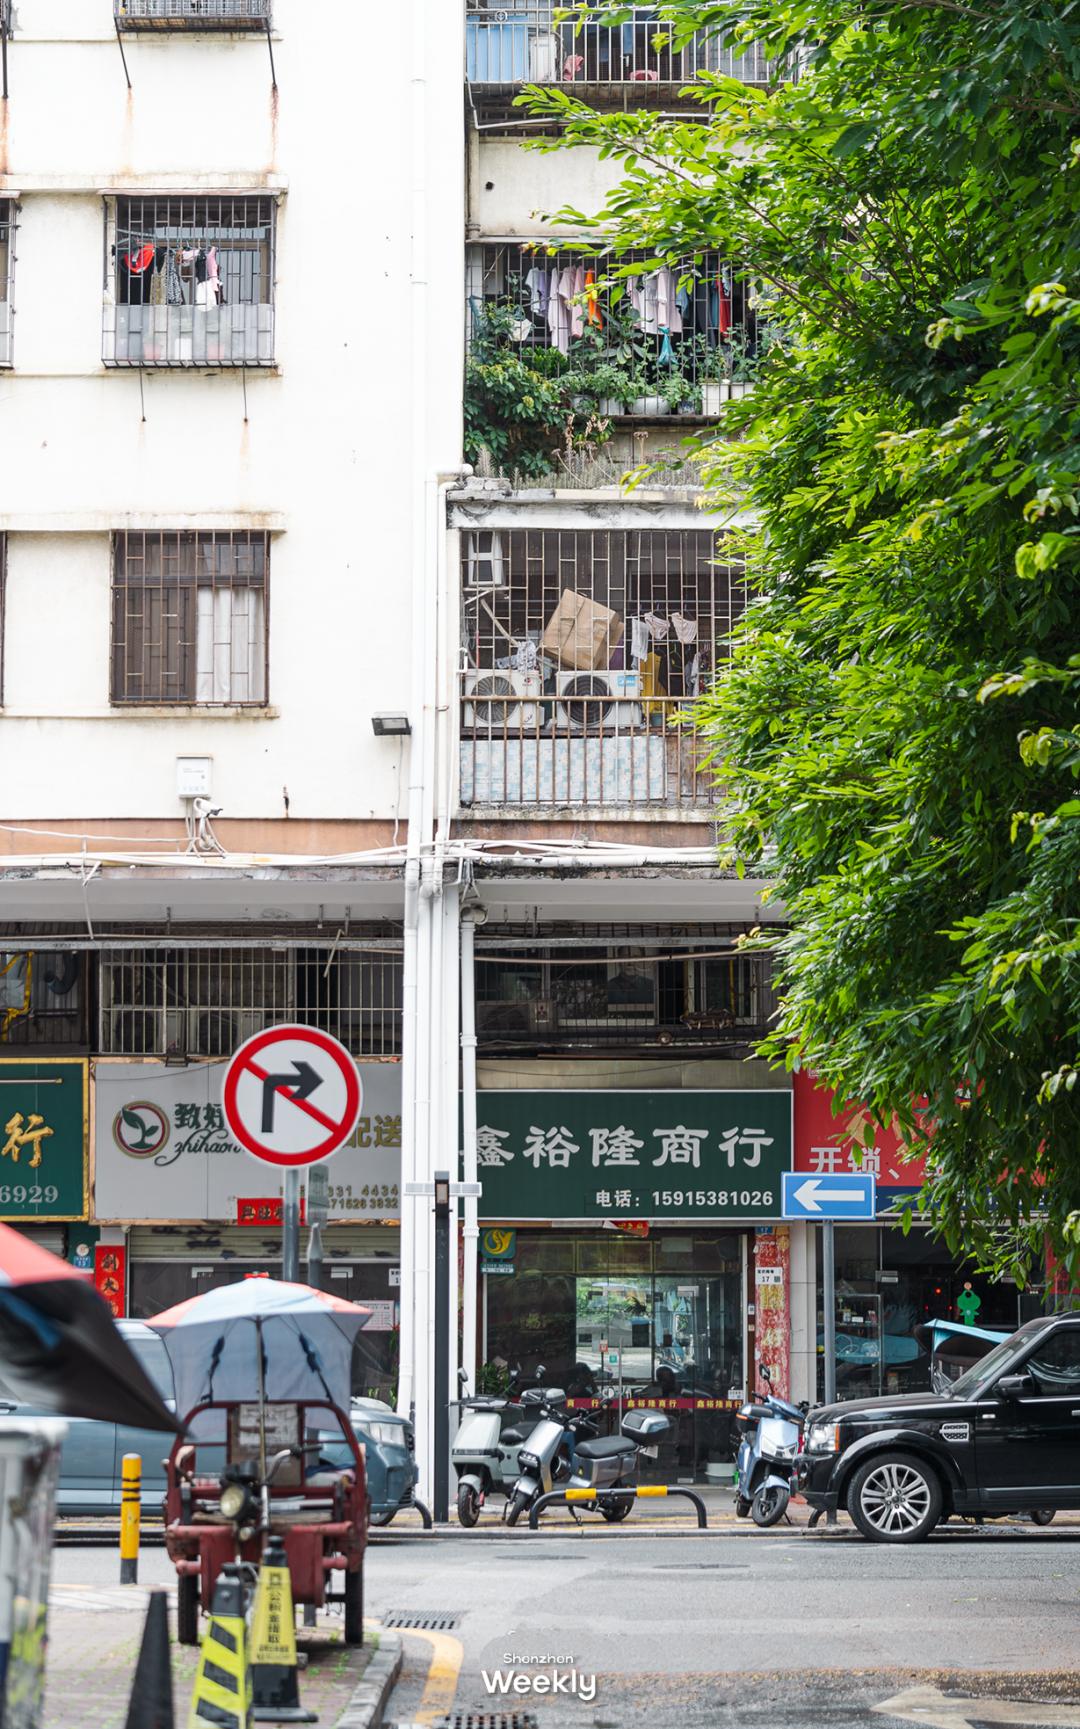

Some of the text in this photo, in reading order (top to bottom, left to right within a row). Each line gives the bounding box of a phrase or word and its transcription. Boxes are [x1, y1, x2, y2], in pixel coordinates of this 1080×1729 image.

[1, 1112, 54, 1168] 行
[459, 1124, 774, 1169] 鑫裕隆商行
[0, 1185, 58, 1203] 6929
[652, 1190, 773, 1207] 15915381026
